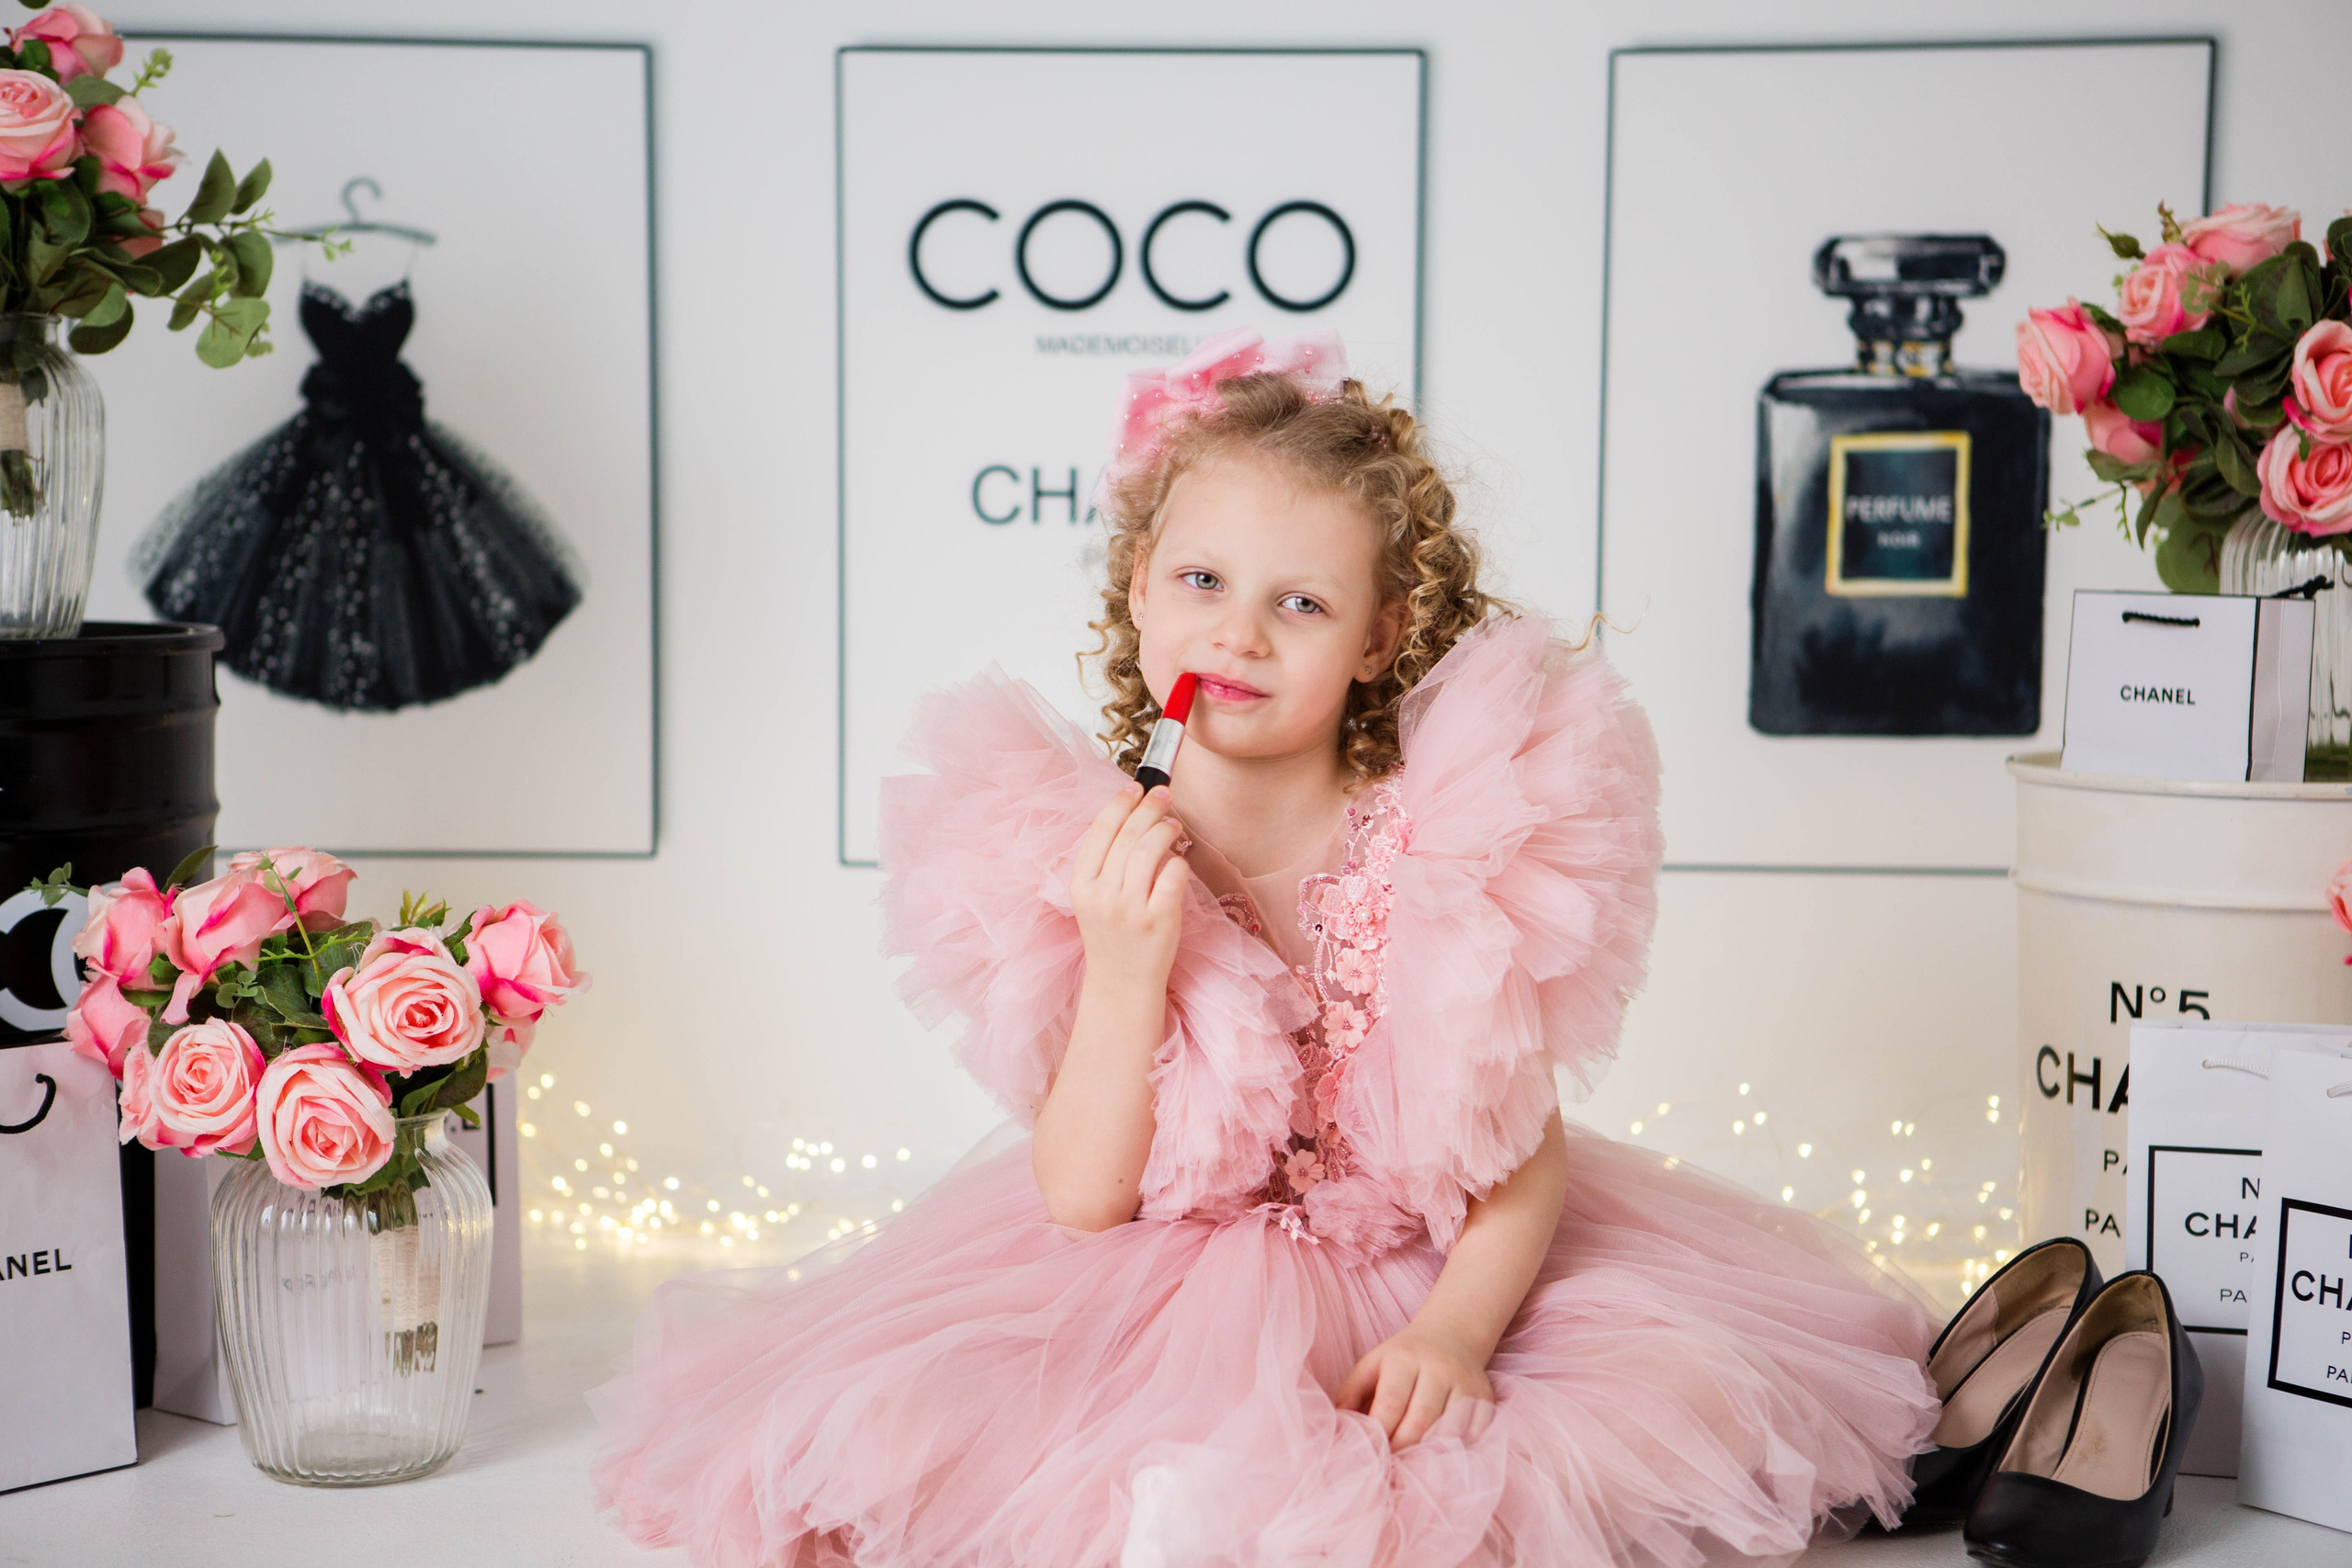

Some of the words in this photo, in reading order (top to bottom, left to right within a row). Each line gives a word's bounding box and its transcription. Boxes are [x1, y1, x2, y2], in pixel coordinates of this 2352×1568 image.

[908, 198, 1356, 313] COCO
[1035, 334, 1199, 355] MADEMOISEL
[1846, 495, 1951, 522] PERFUME
[2120, 685, 2195, 705] CHANEL
[2086, 1208, 2120, 1238] PA
[2220, 1288, 2247, 1303] PA
[2327, 1365, 2352, 1384] PA
